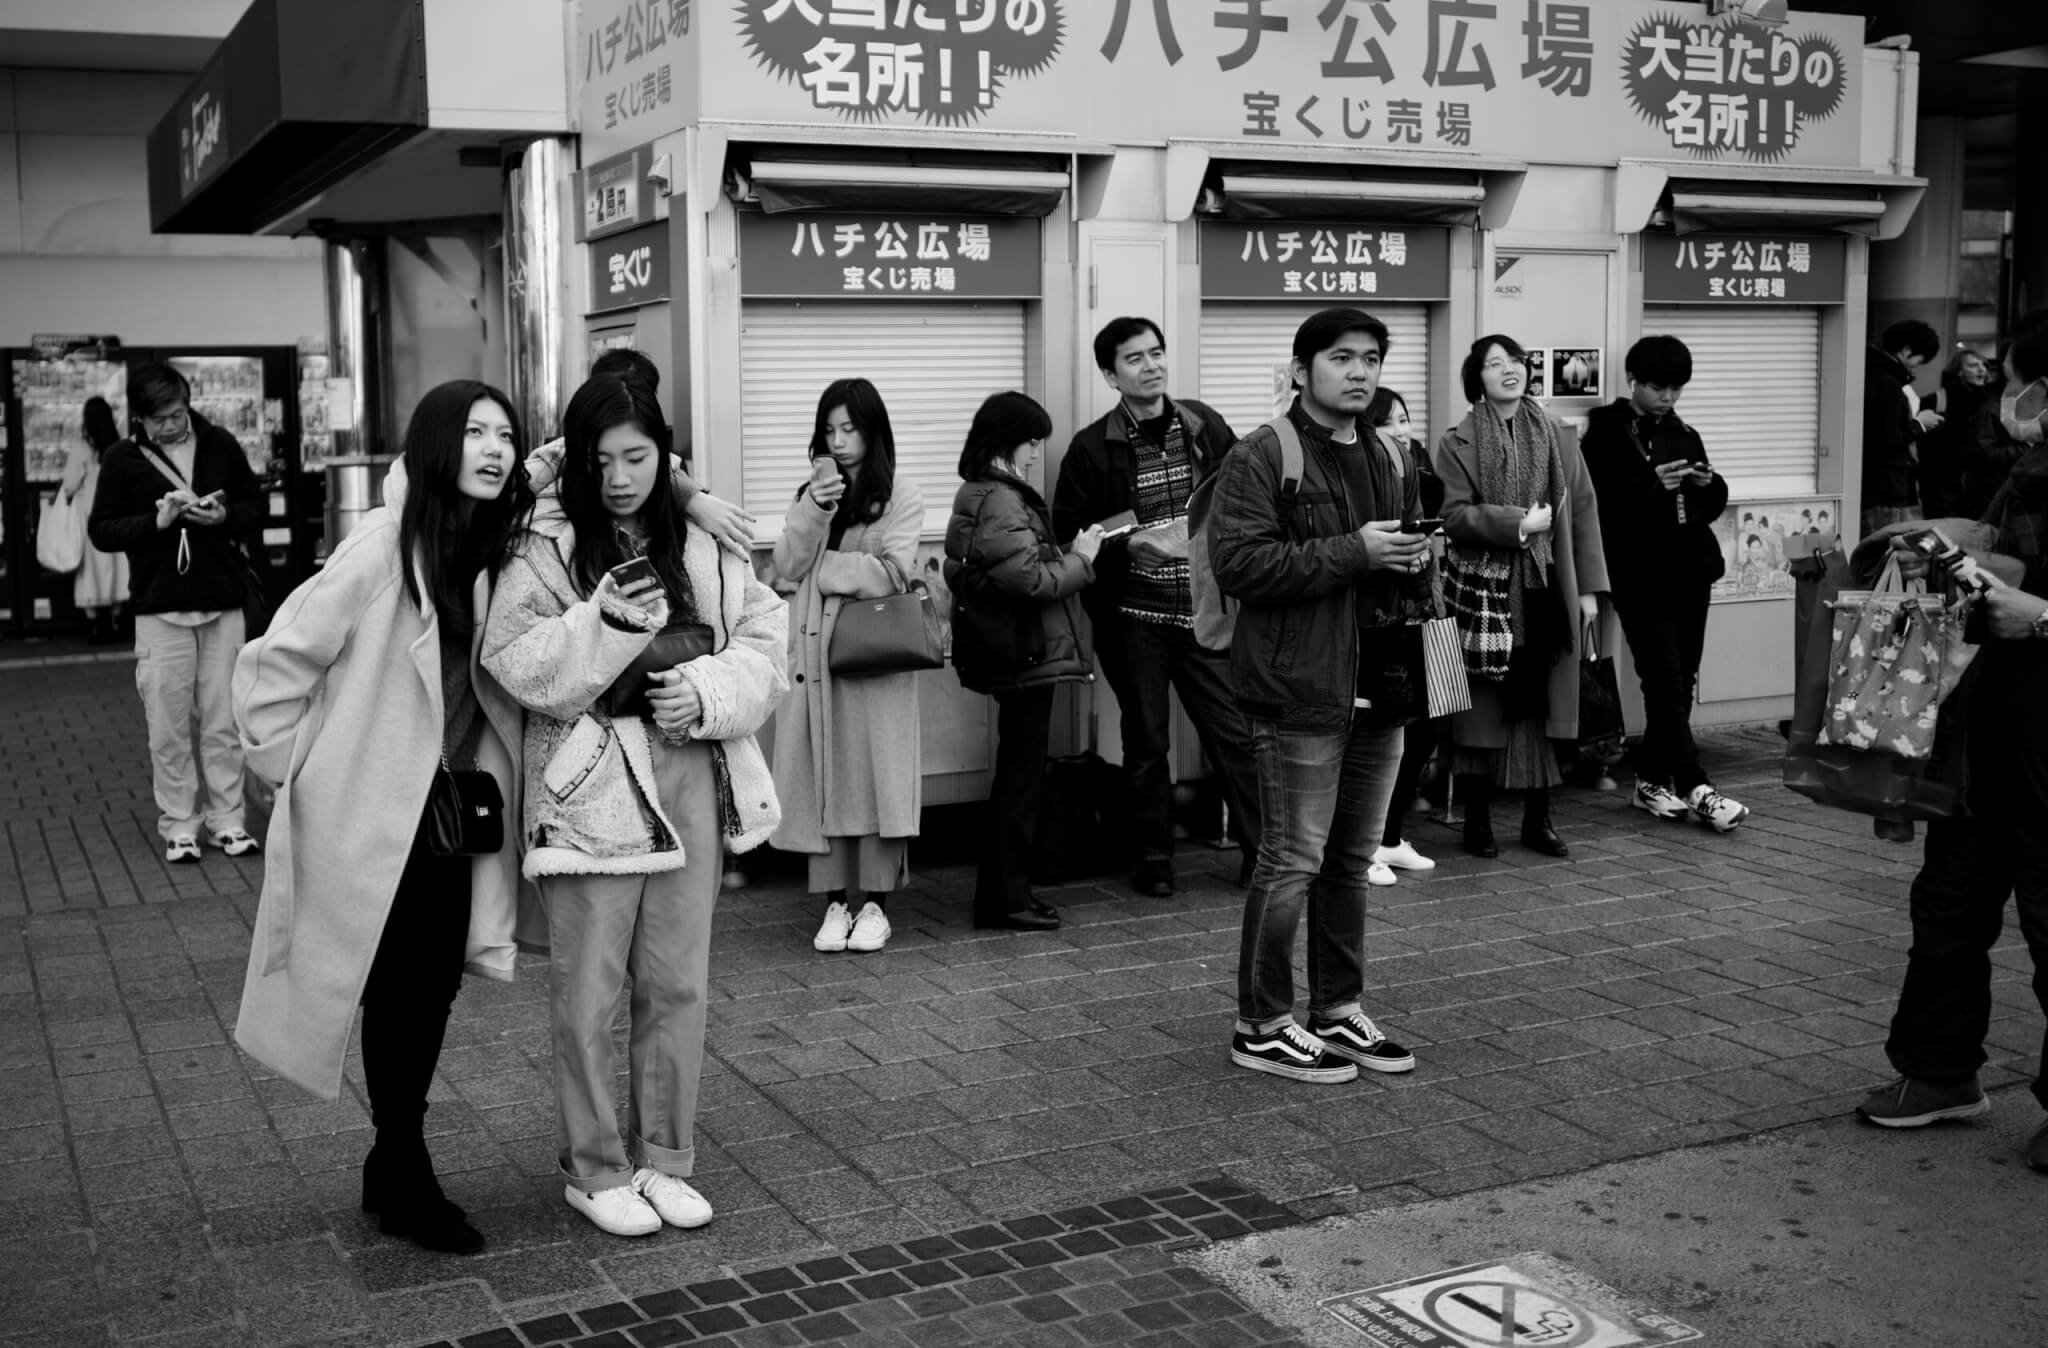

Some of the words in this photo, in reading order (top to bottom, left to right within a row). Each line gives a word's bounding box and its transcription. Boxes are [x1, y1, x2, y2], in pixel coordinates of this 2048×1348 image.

[586, 0, 690, 82] ハチ公広場
[1099, 0, 1595, 98] ハチ公広場
[1638, 25, 1835, 88] 大当たりの
[604, 64, 672, 130] 宝くじ売場
[802, 36, 991, 108] 名所!!
[1242, 90, 1472, 146] 宝くじ売場
[1665, 90, 1796, 149] 名所!!
[790, 221, 993, 262] ハチ公広場
[1240, 230, 1408, 267] ハチ公広場
[1675, 240, 1812, 273] ハチ公広場
[608, 246, 652, 293] 宝くじ
[842, 266, 957, 292] 宝くじ売場
[1283, 270, 1378, 294] 宝くじ売場
[1708, 277, 1786, 298] 宝くじ売場
